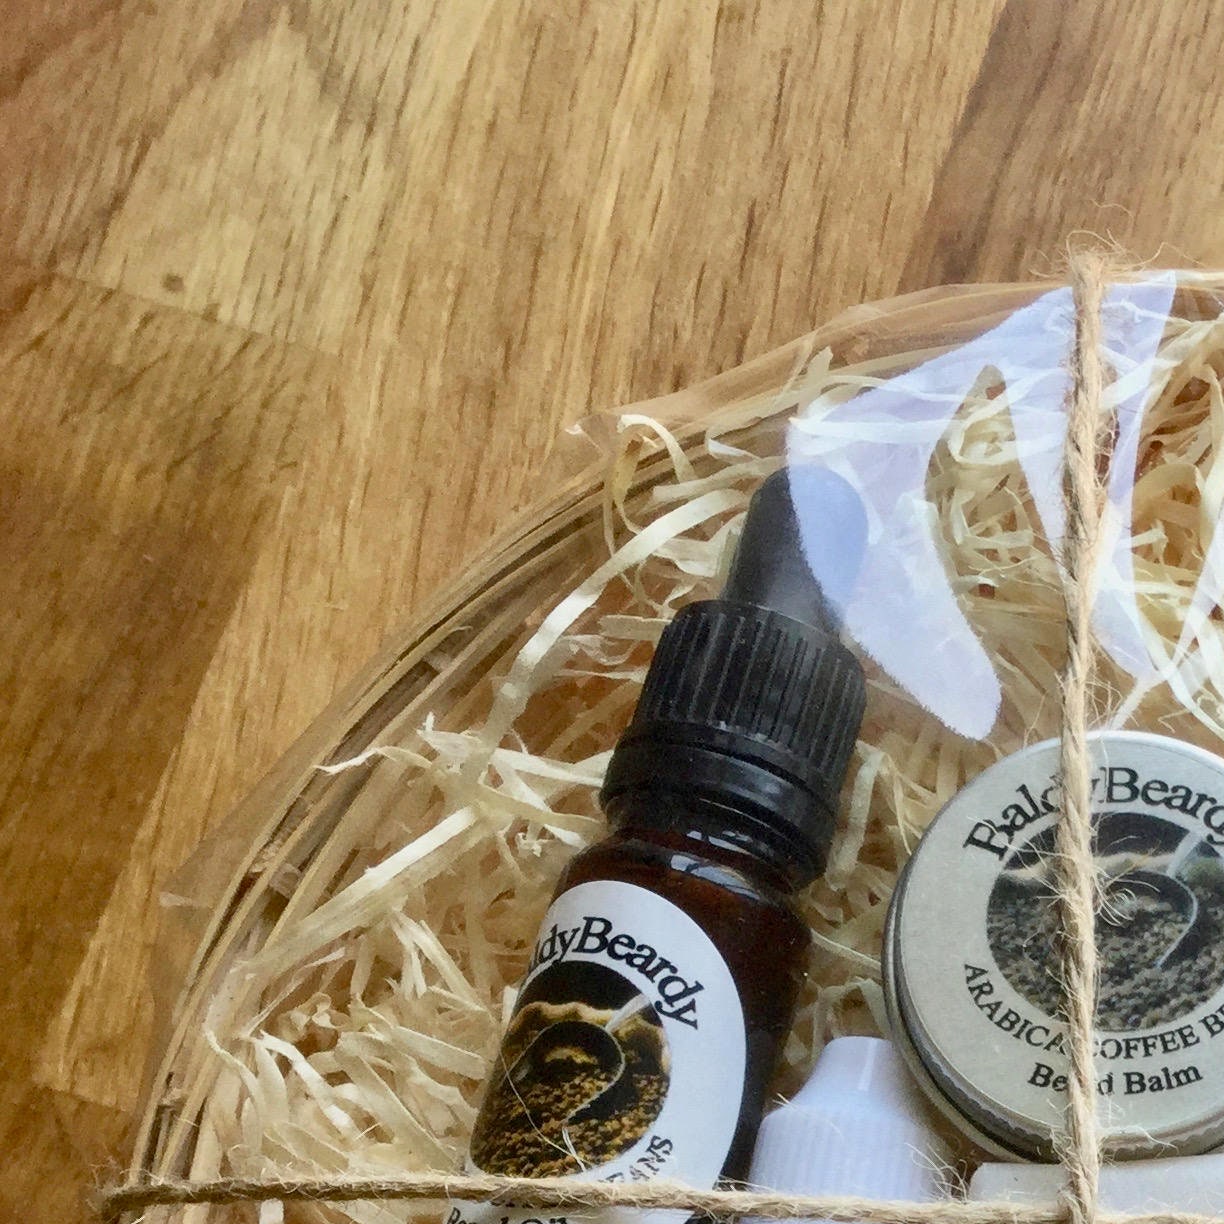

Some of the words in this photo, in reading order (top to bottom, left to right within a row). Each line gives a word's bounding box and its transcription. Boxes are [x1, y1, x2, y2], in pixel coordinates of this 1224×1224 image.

[964, 962, 1068, 1055] ARABICA
[1092, 1024, 1200, 1059] OFFEE
[1027, 1062, 1115, 1096] Bed
[1124, 1065, 1203, 1095] Balm
